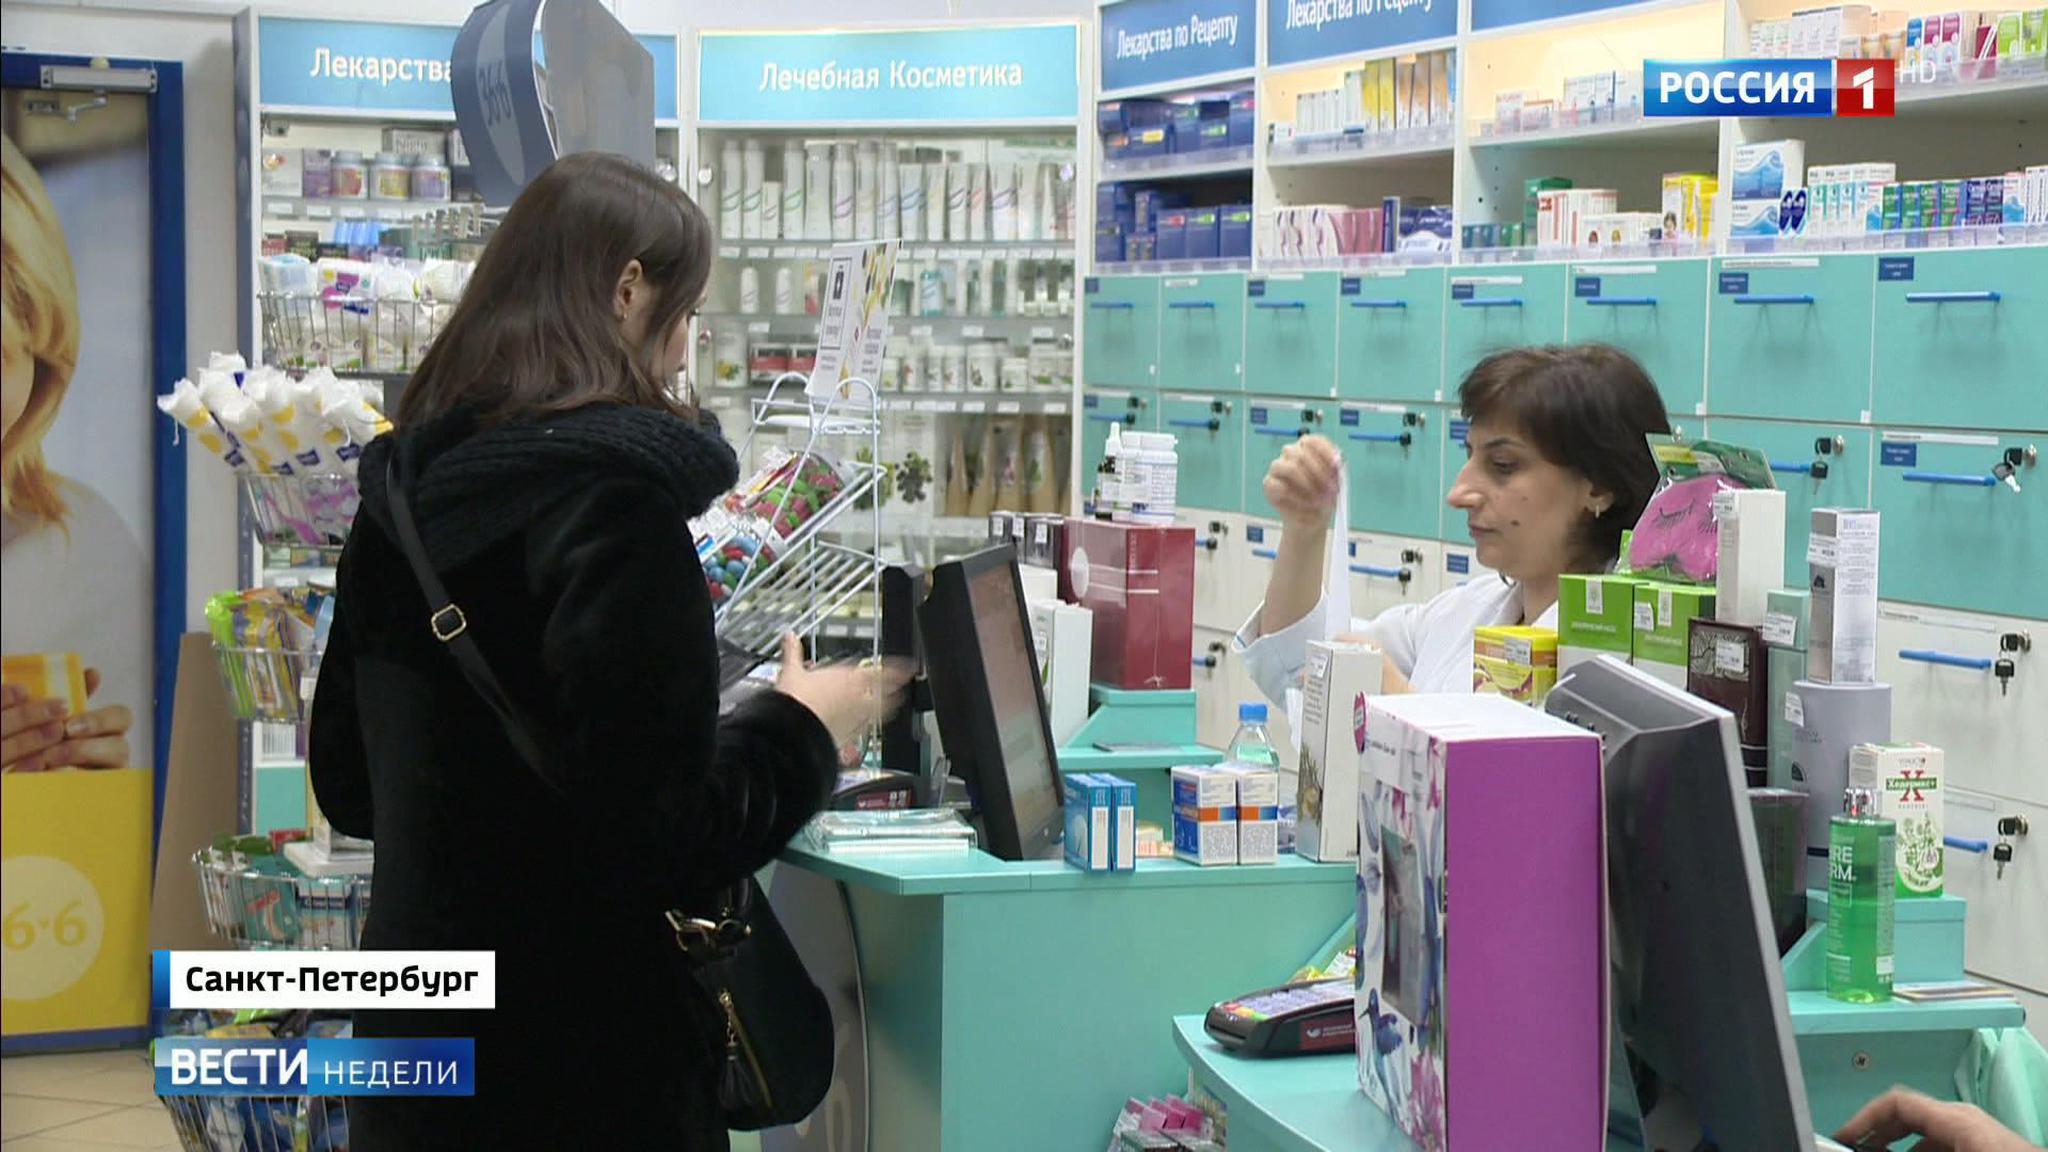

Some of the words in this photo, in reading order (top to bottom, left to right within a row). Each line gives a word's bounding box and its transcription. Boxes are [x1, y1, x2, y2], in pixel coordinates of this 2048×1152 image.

[1117, 28, 1172, 60] Лекарства
[1174, 25, 1188, 47] по
[1190, 14, 1237, 47] Рецепту
[759, 60, 879, 92] Лечебная
[889, 59, 1023, 90] Косметика
